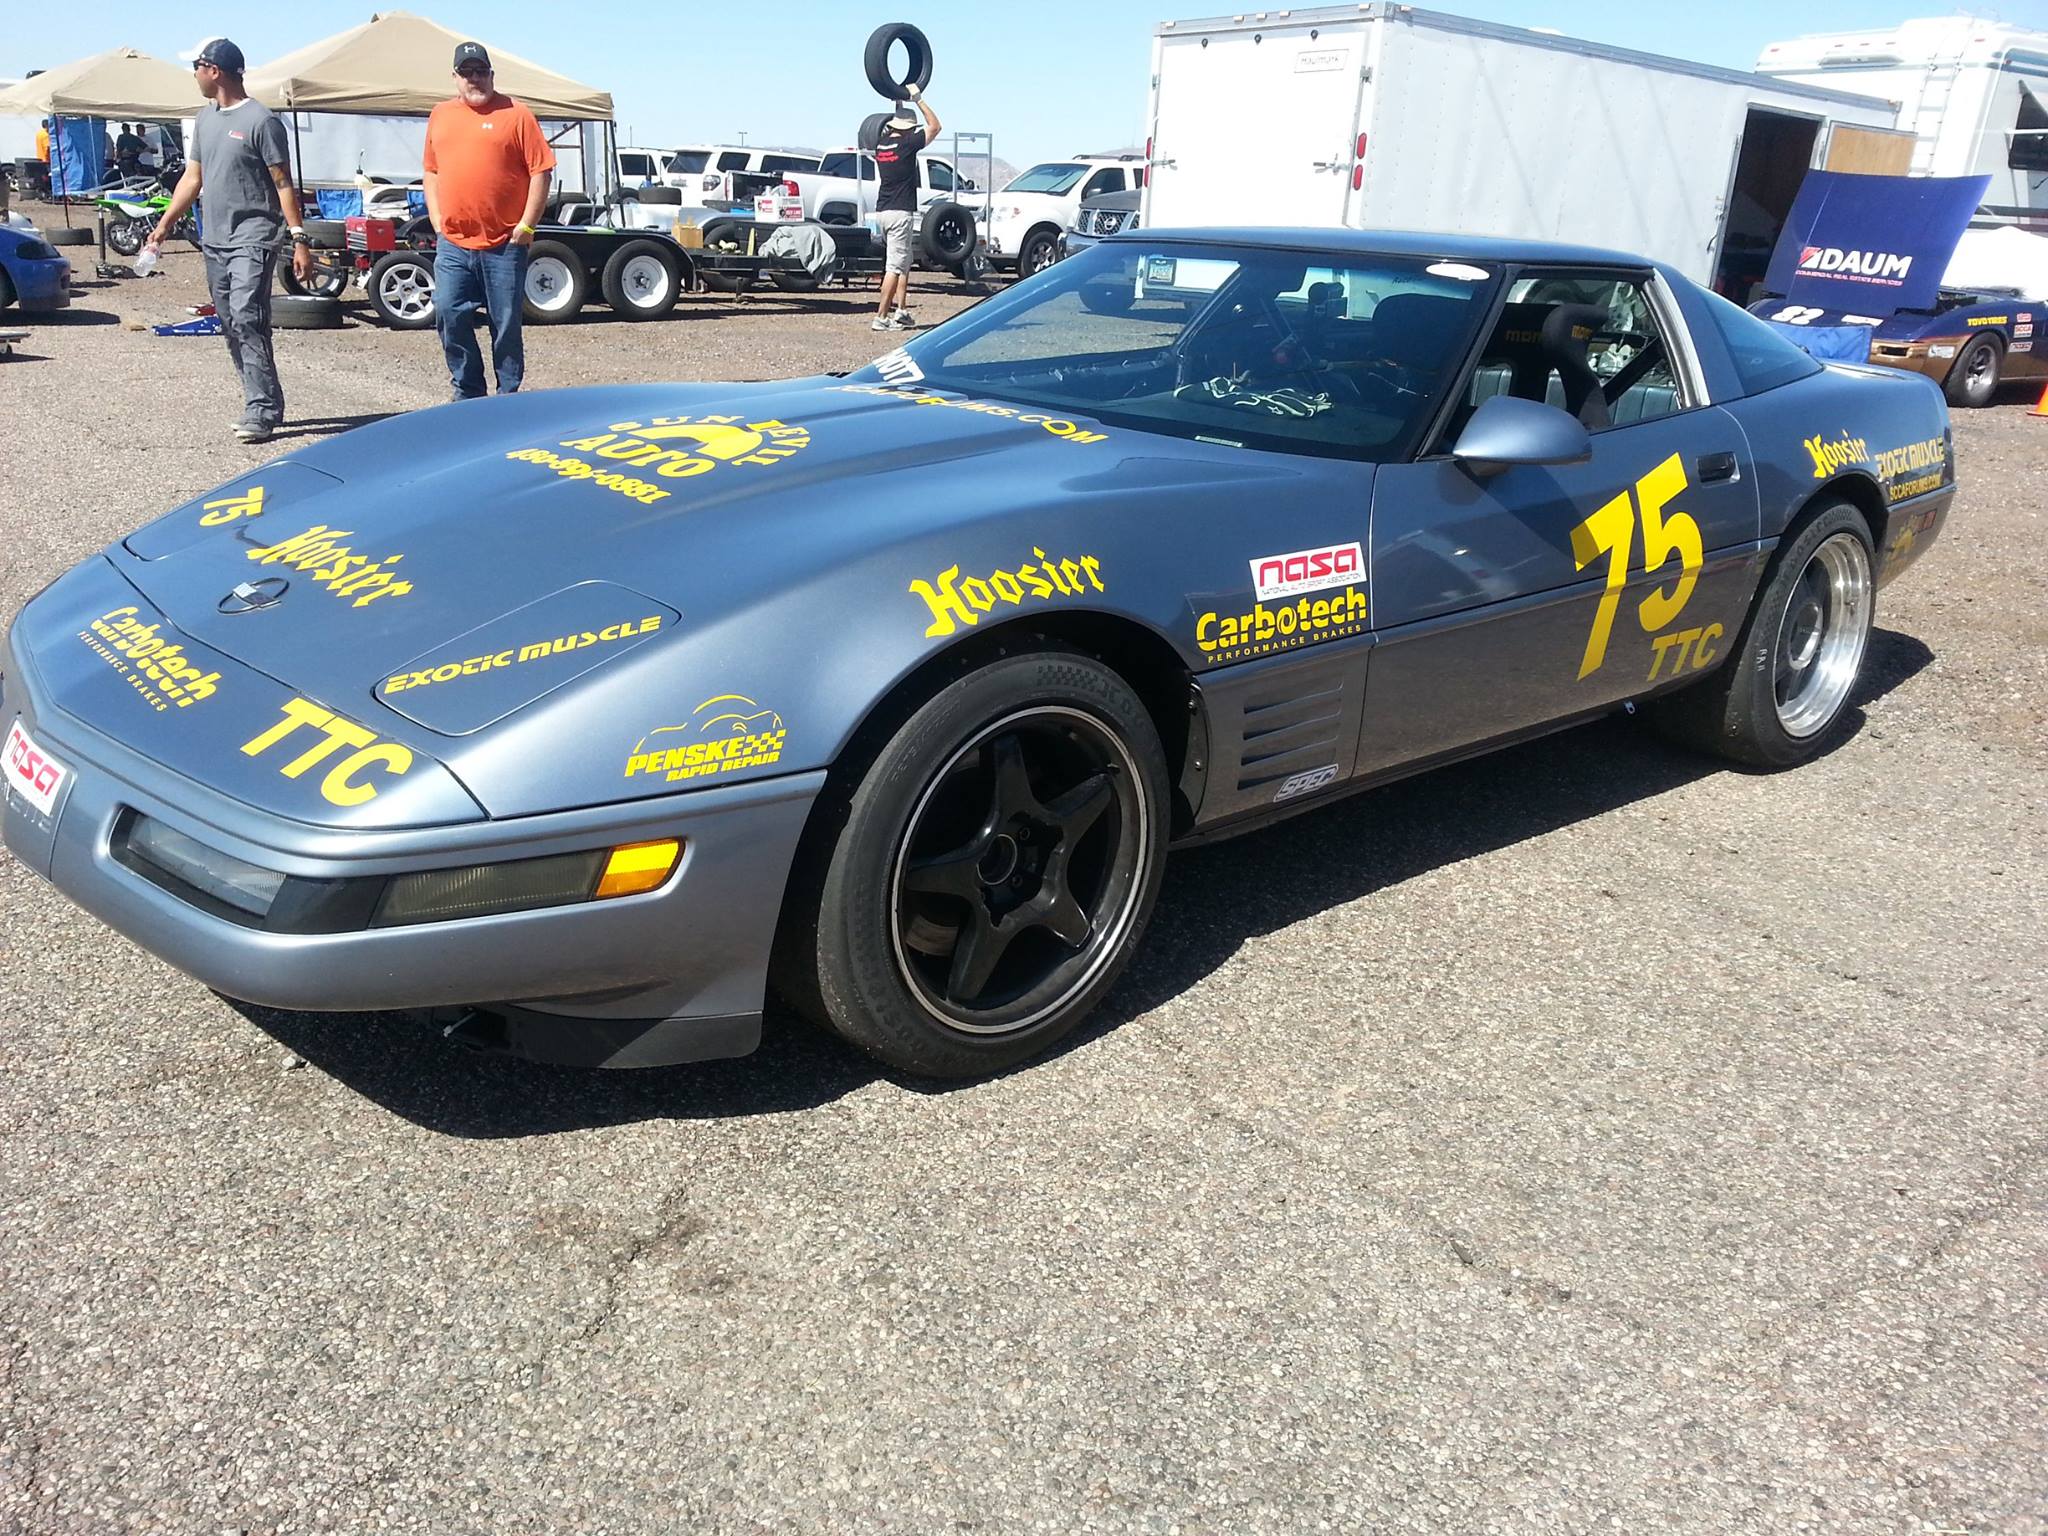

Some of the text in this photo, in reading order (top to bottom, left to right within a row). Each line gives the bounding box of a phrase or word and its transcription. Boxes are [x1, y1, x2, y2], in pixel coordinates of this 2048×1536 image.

[1819, 248, 1913, 279] DAUM
[1771, 305, 1825, 325] 82
[558, 433, 716, 478] AUTO
[1803, 428, 1870, 479] Hoosier
[199, 486, 264, 526] 75
[245, 524, 413, 608] Hoosier
[1569, 451, 1704, 683] 75
[908, 546, 1105, 639] Hoosier
[1196, 586, 1367, 652] Carbotech
[91, 606, 222, 708] Carbotech
[1208, 624, 1362, 664] PERFORMANCE BRAKES
[1646, 622, 1724, 683] TTC
[76, 631, 168, 711] PERFORMANCE BRAKES
[384, 650, 514, 695] EXOTIC
[239, 697, 414, 807] TTC
[624, 736, 747, 777] PENSKE
[666, 752, 780, 782] RAPID REPAIR
[1276, 766, 1337, 799] SPEC
